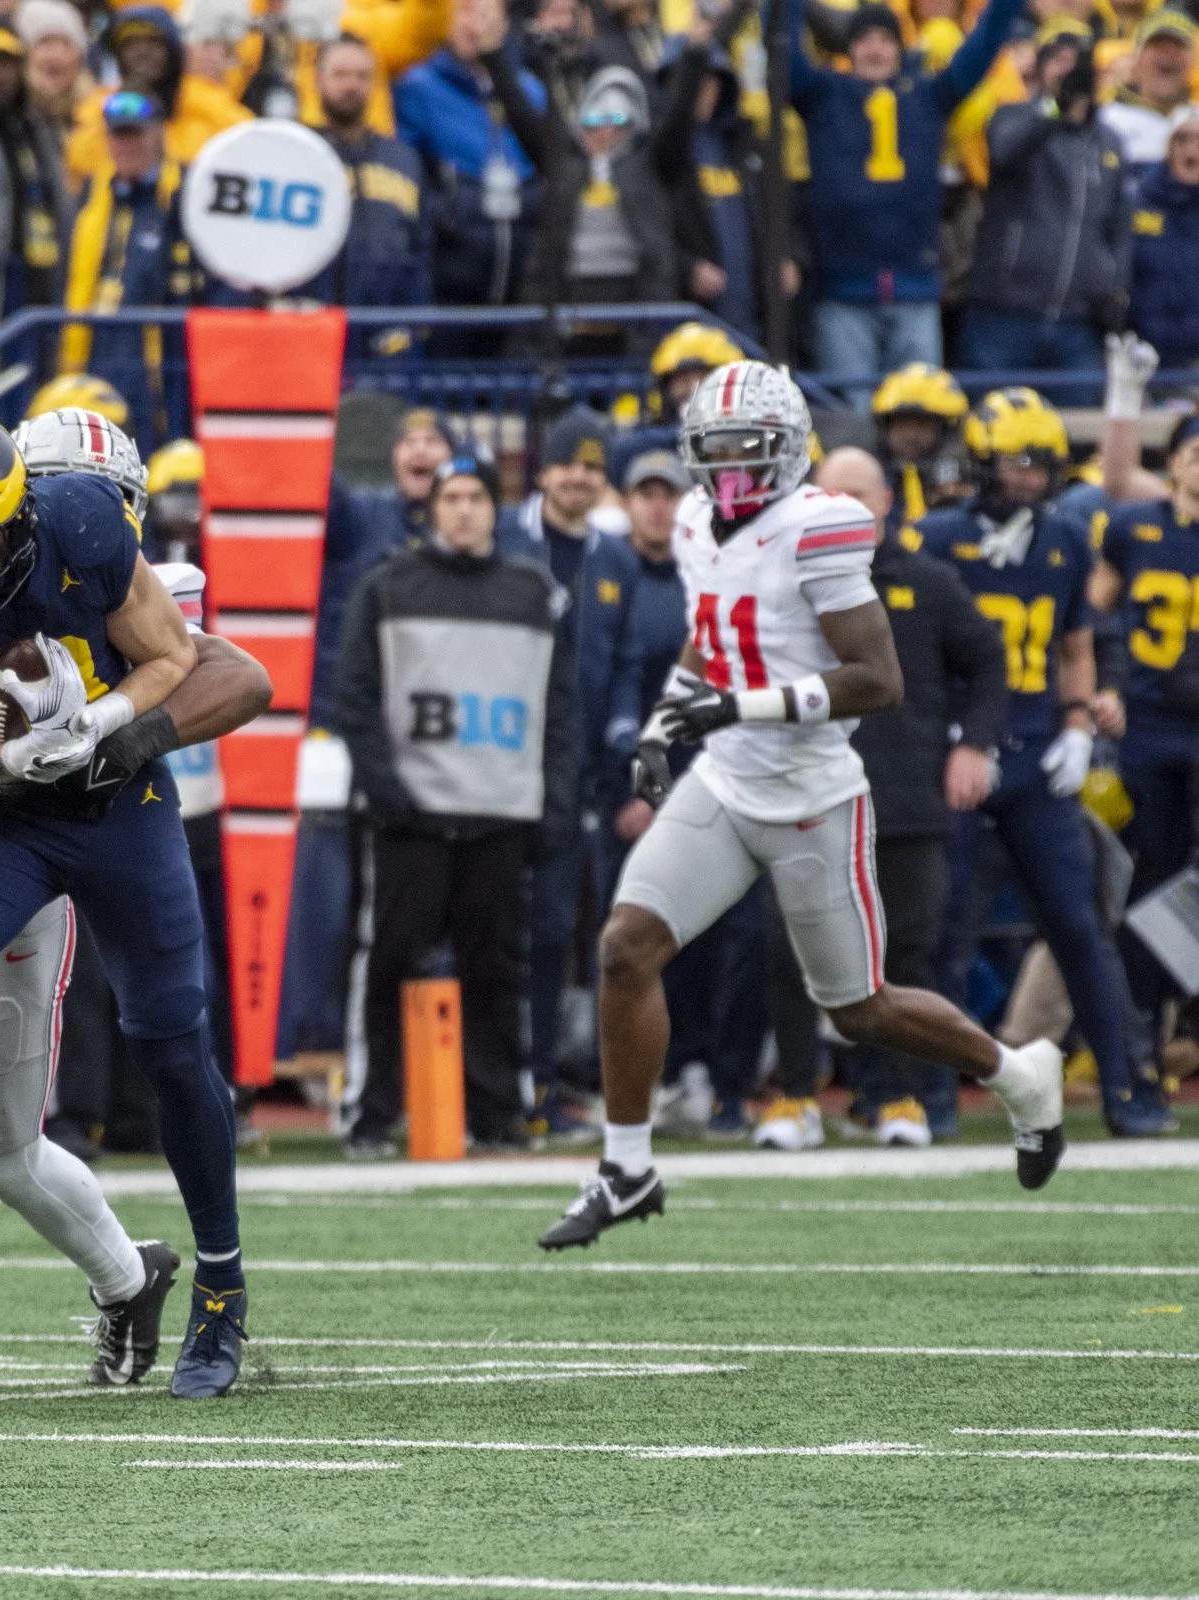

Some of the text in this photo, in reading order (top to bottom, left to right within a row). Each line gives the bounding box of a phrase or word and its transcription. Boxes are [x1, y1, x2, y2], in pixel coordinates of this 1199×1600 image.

[865, 87, 906, 182] 1
[208, 171, 324, 229] B1G
[693, 592, 769, 691] 41
[1129, 569, 1199, 670] 3
